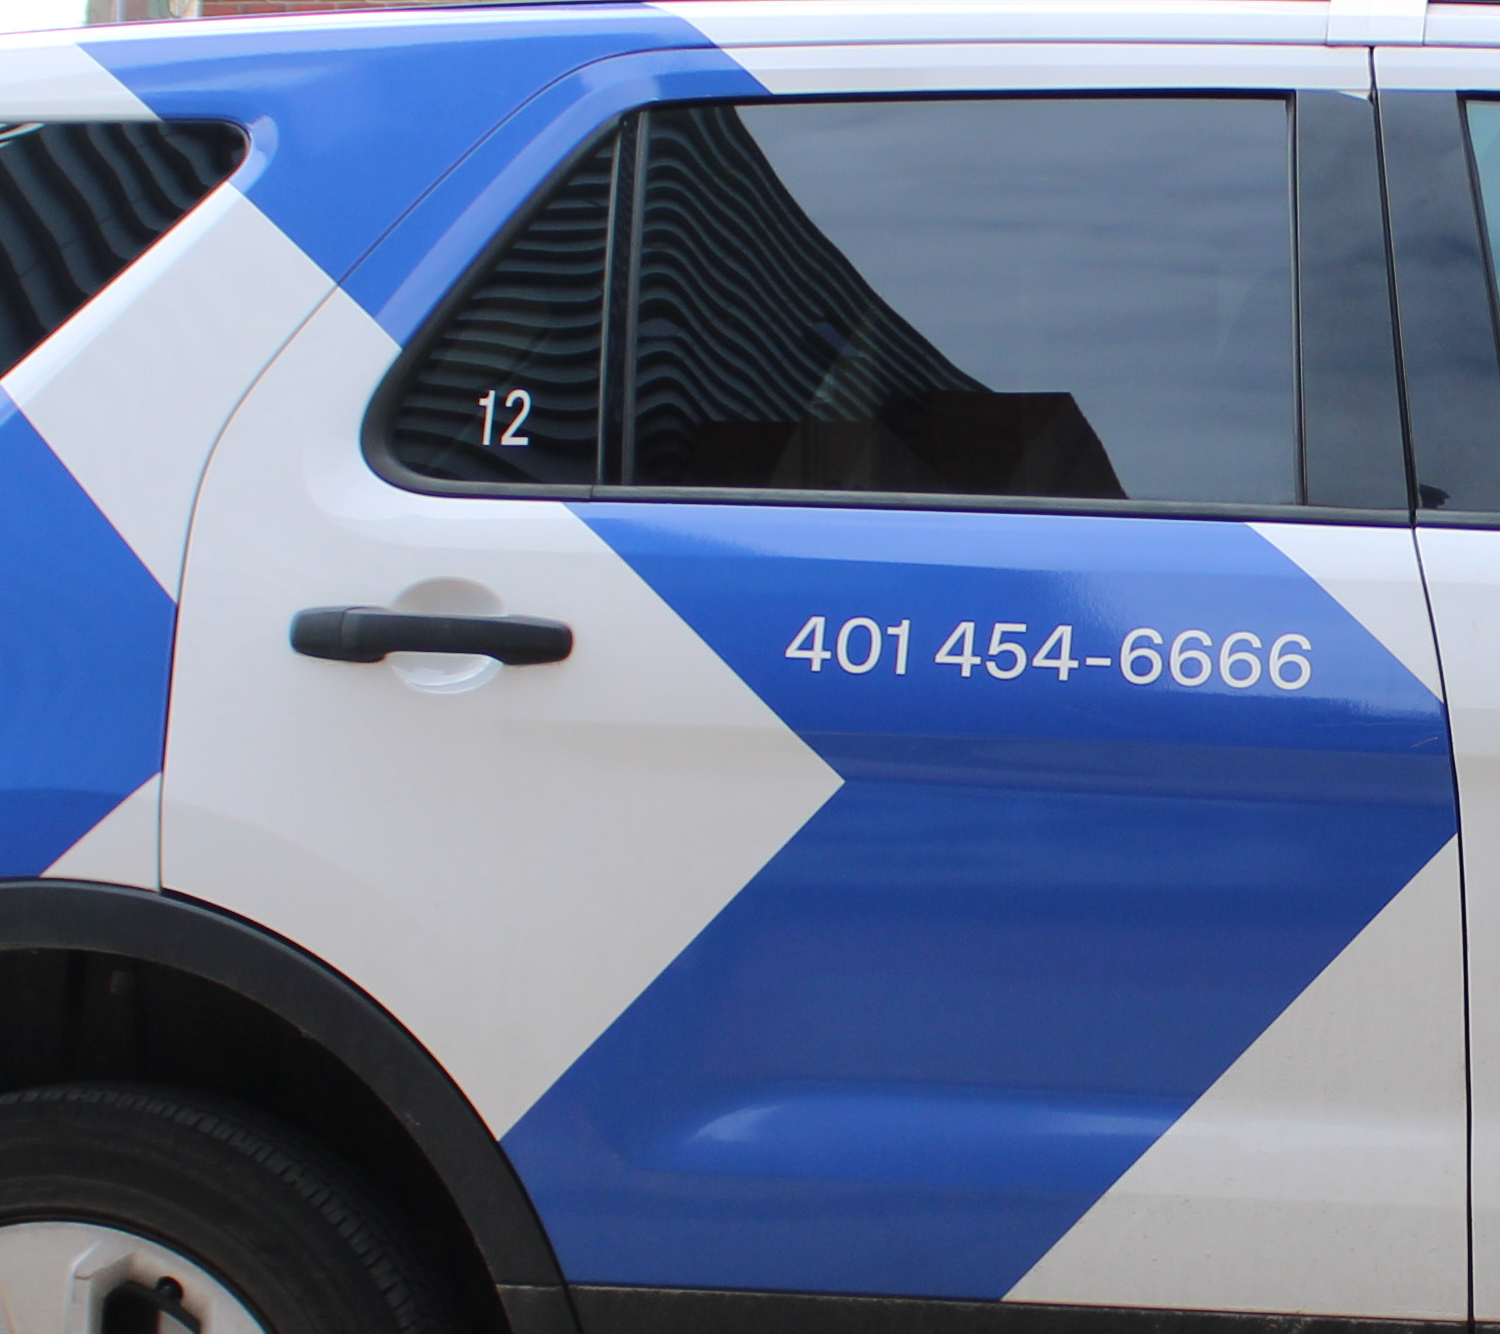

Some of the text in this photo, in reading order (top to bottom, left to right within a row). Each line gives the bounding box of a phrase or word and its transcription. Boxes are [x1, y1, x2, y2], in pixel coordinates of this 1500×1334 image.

[478, 389, 531, 446] 12
[785, 616, 1312, 690] 401 454-6666
